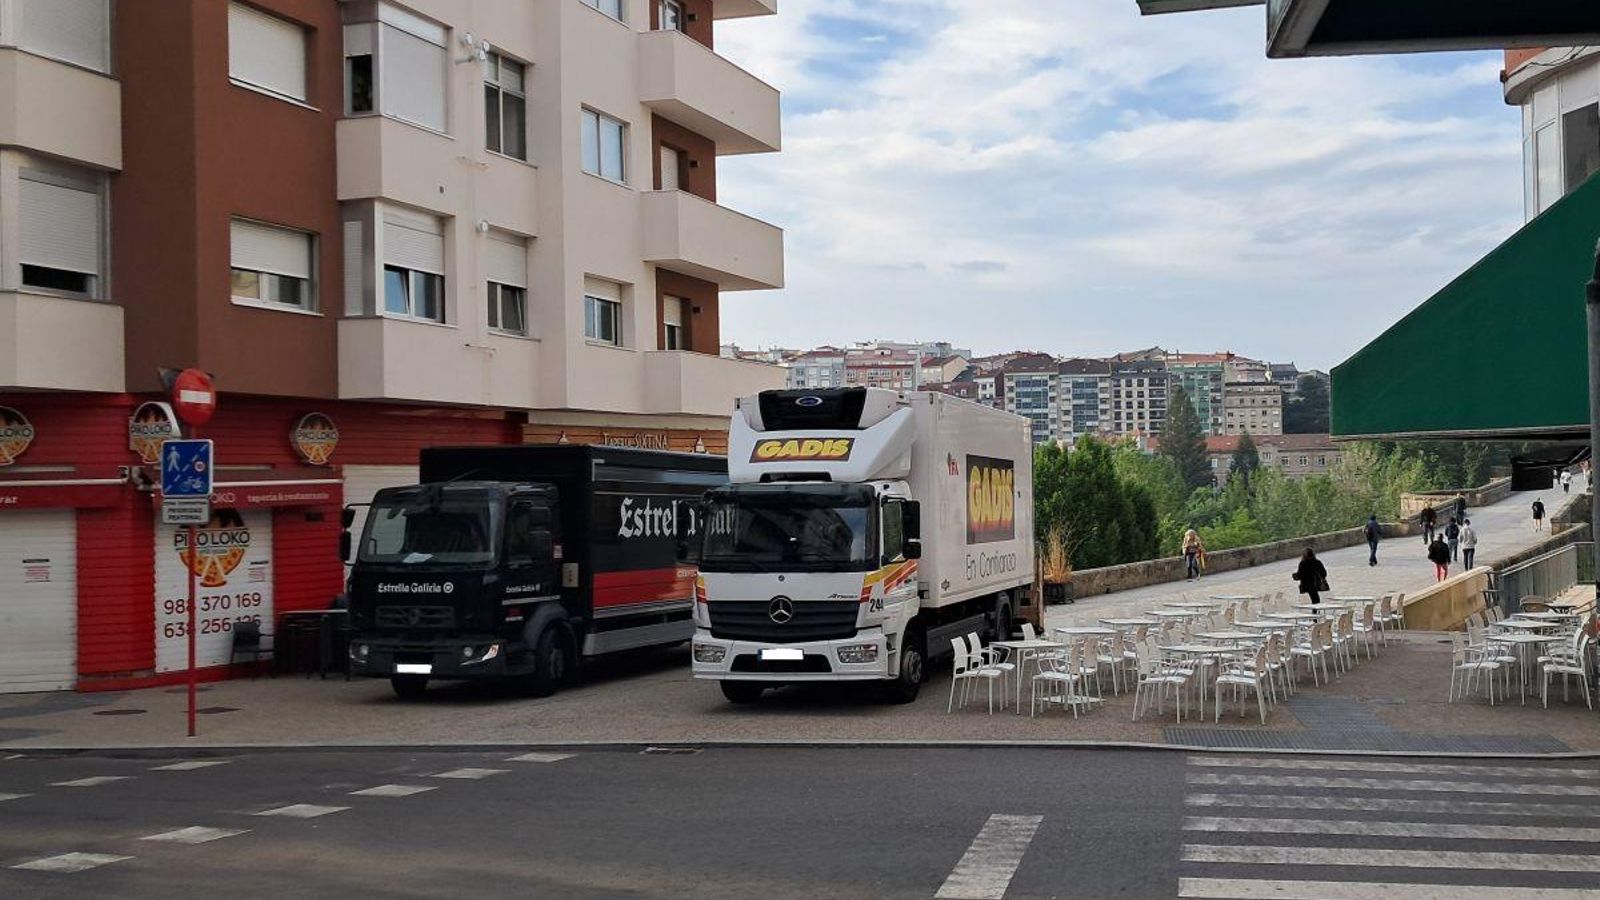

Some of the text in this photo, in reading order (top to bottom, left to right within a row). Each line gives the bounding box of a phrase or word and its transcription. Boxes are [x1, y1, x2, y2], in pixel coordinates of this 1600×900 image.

[757, 439, 850, 459] GADIS
[209, 492, 236, 504] OKO
[970, 465, 1014, 530] GADIS
[174, 531, 251, 547] PIO LOKO
[377, 582, 441, 593] Estrella Galicia
[164, 592, 261, 615] 98 370 169
[164, 621, 190, 638] 63
[201, 617, 231, 634] 256
